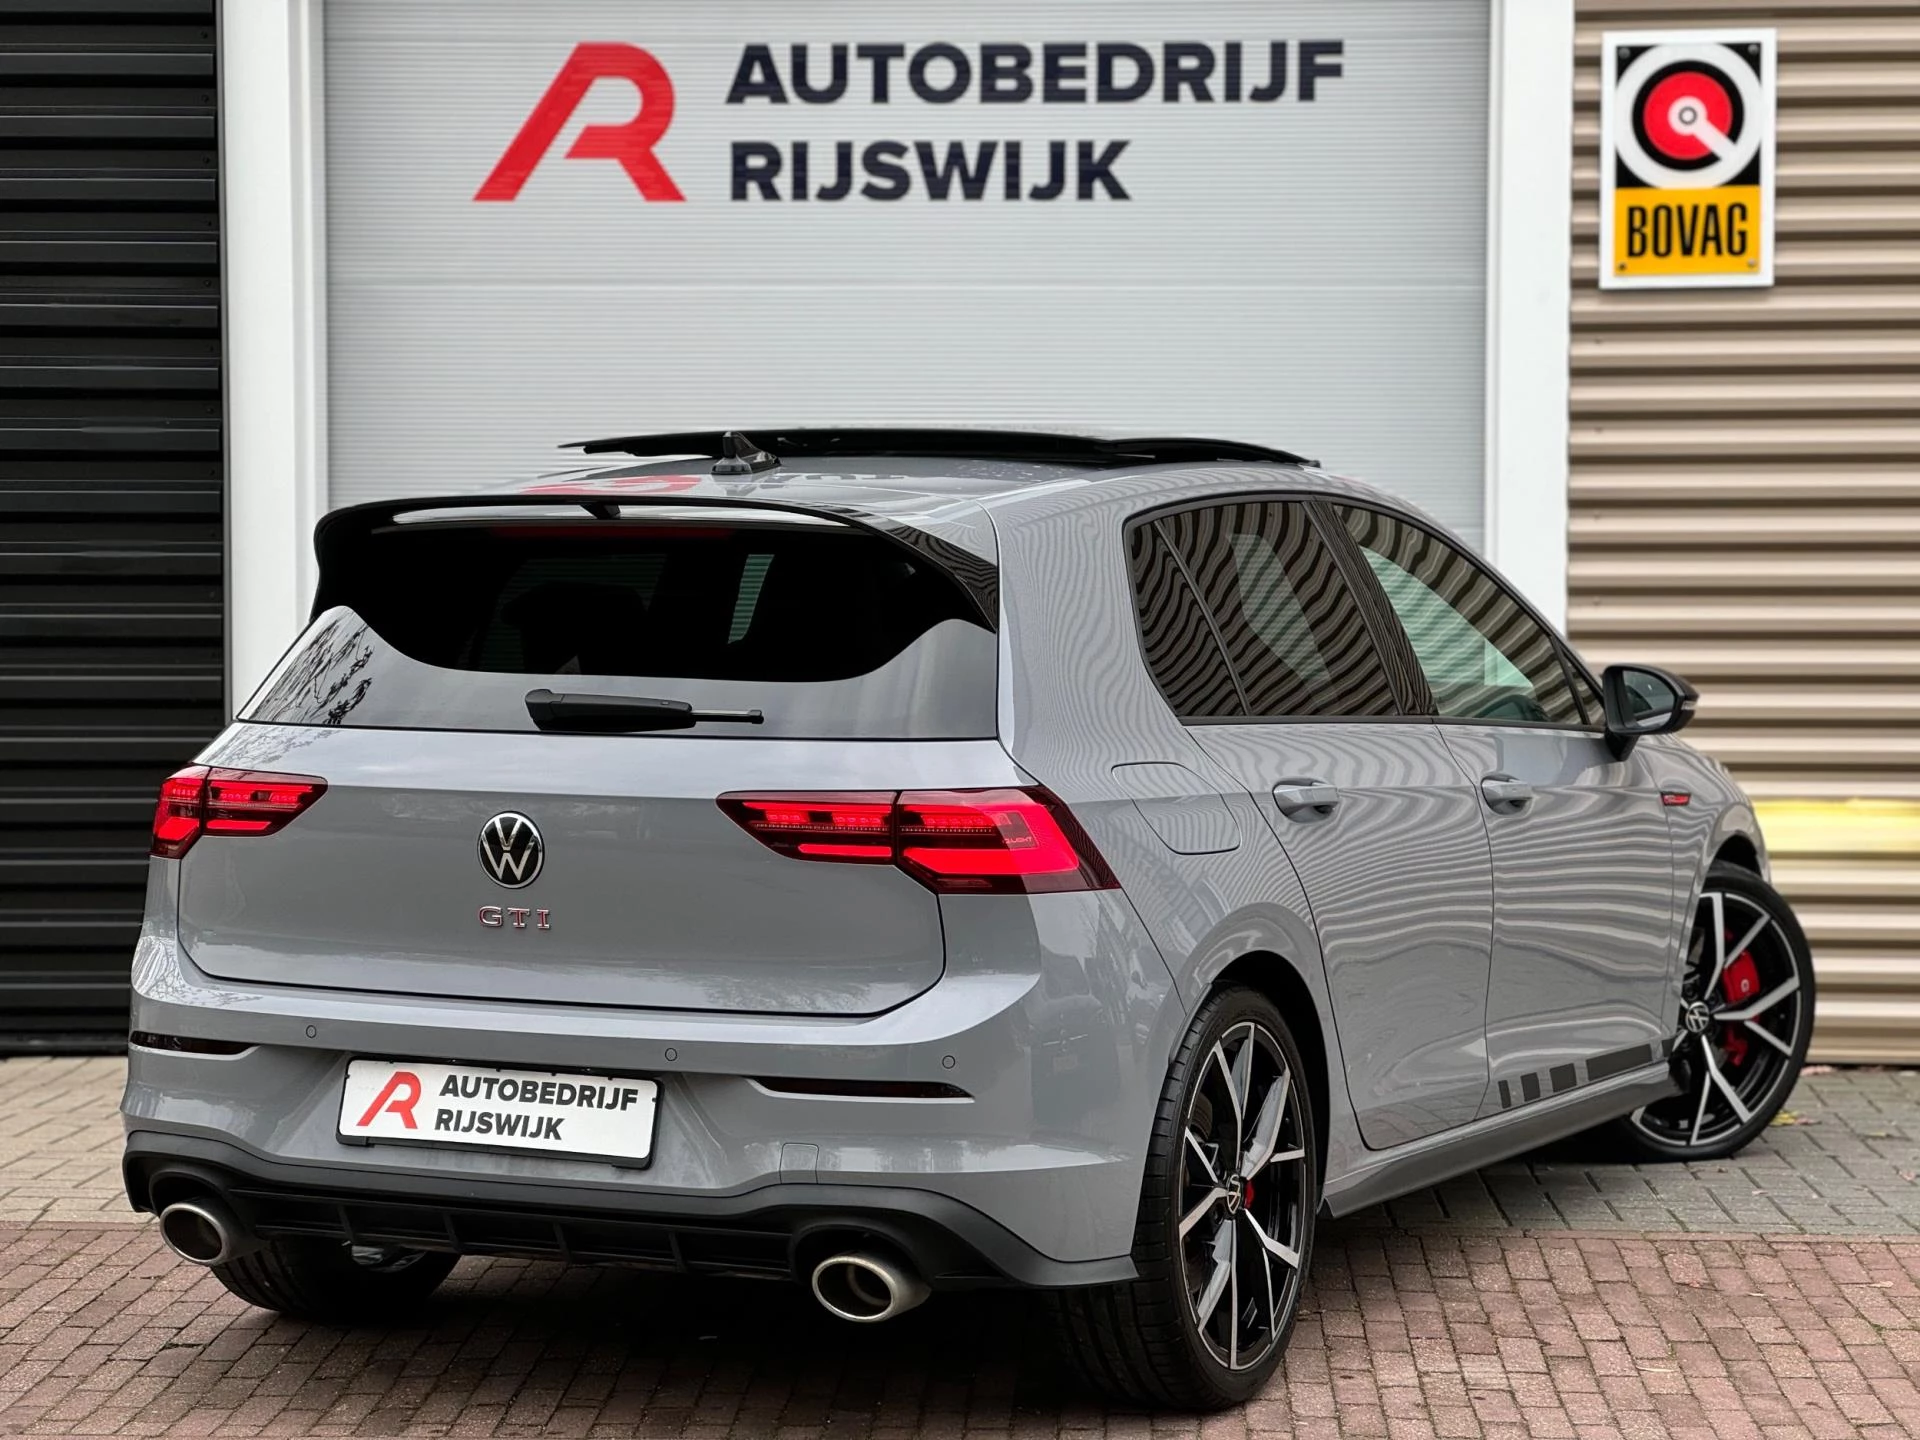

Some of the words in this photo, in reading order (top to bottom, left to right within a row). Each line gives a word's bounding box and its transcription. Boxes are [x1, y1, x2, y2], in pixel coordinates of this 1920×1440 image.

[727, 40, 1344, 104] AUTOBEDRIJF
[731, 140, 1130, 202] RIJSWIJK
[1627, 202, 1748, 258] BOVAG
[478, 905, 551, 929] GTI
[439, 1075, 639, 1111] AUTOBEDRIJF
[434, 1109, 563, 1141] RIJSWIJK
